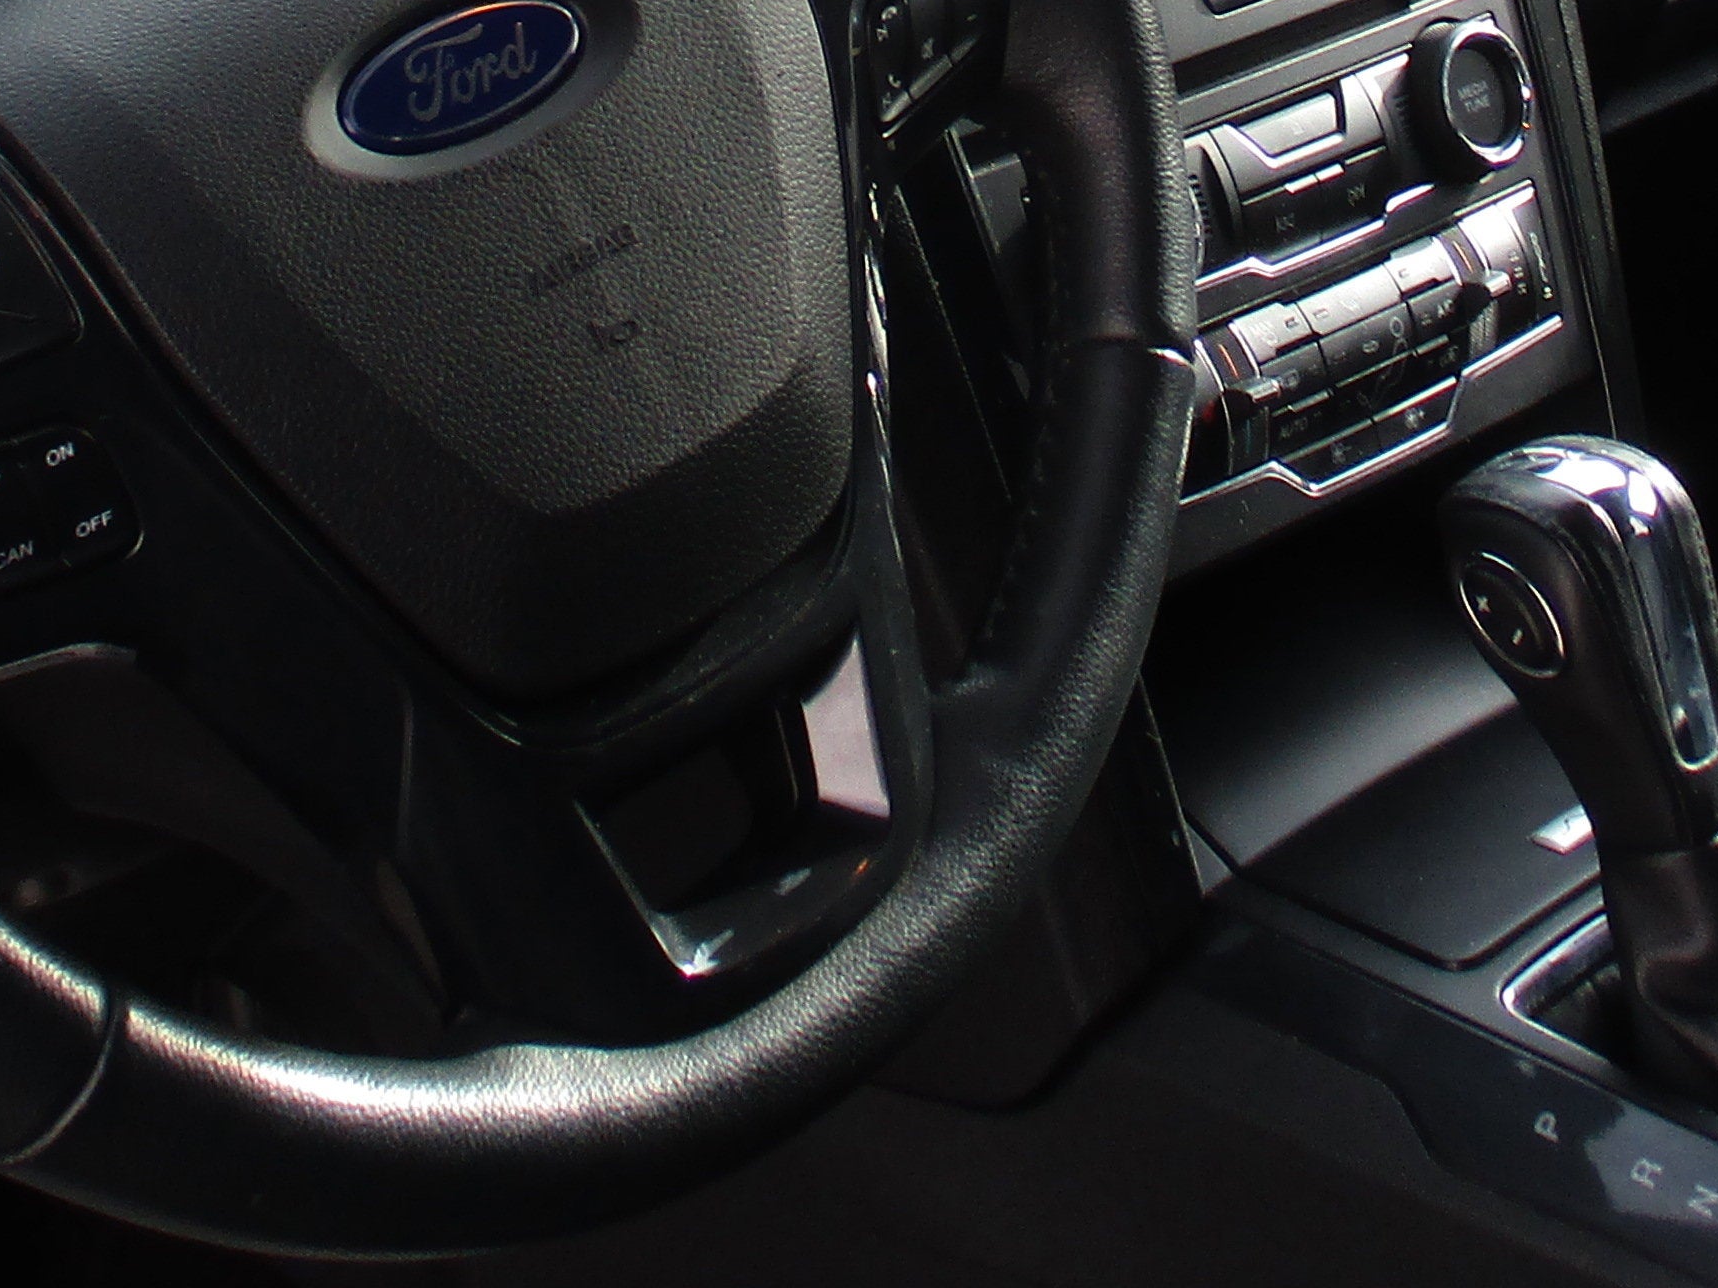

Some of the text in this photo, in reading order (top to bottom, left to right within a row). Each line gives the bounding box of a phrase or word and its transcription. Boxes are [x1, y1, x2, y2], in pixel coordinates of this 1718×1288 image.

[403, 21, 539, 122] Ford
[44, 440, 76, 467] ON
[74, 507, 114, 538] OFF
[1534, 1109, 1560, 1144] P
[1631, 1157, 1664, 1190] R
